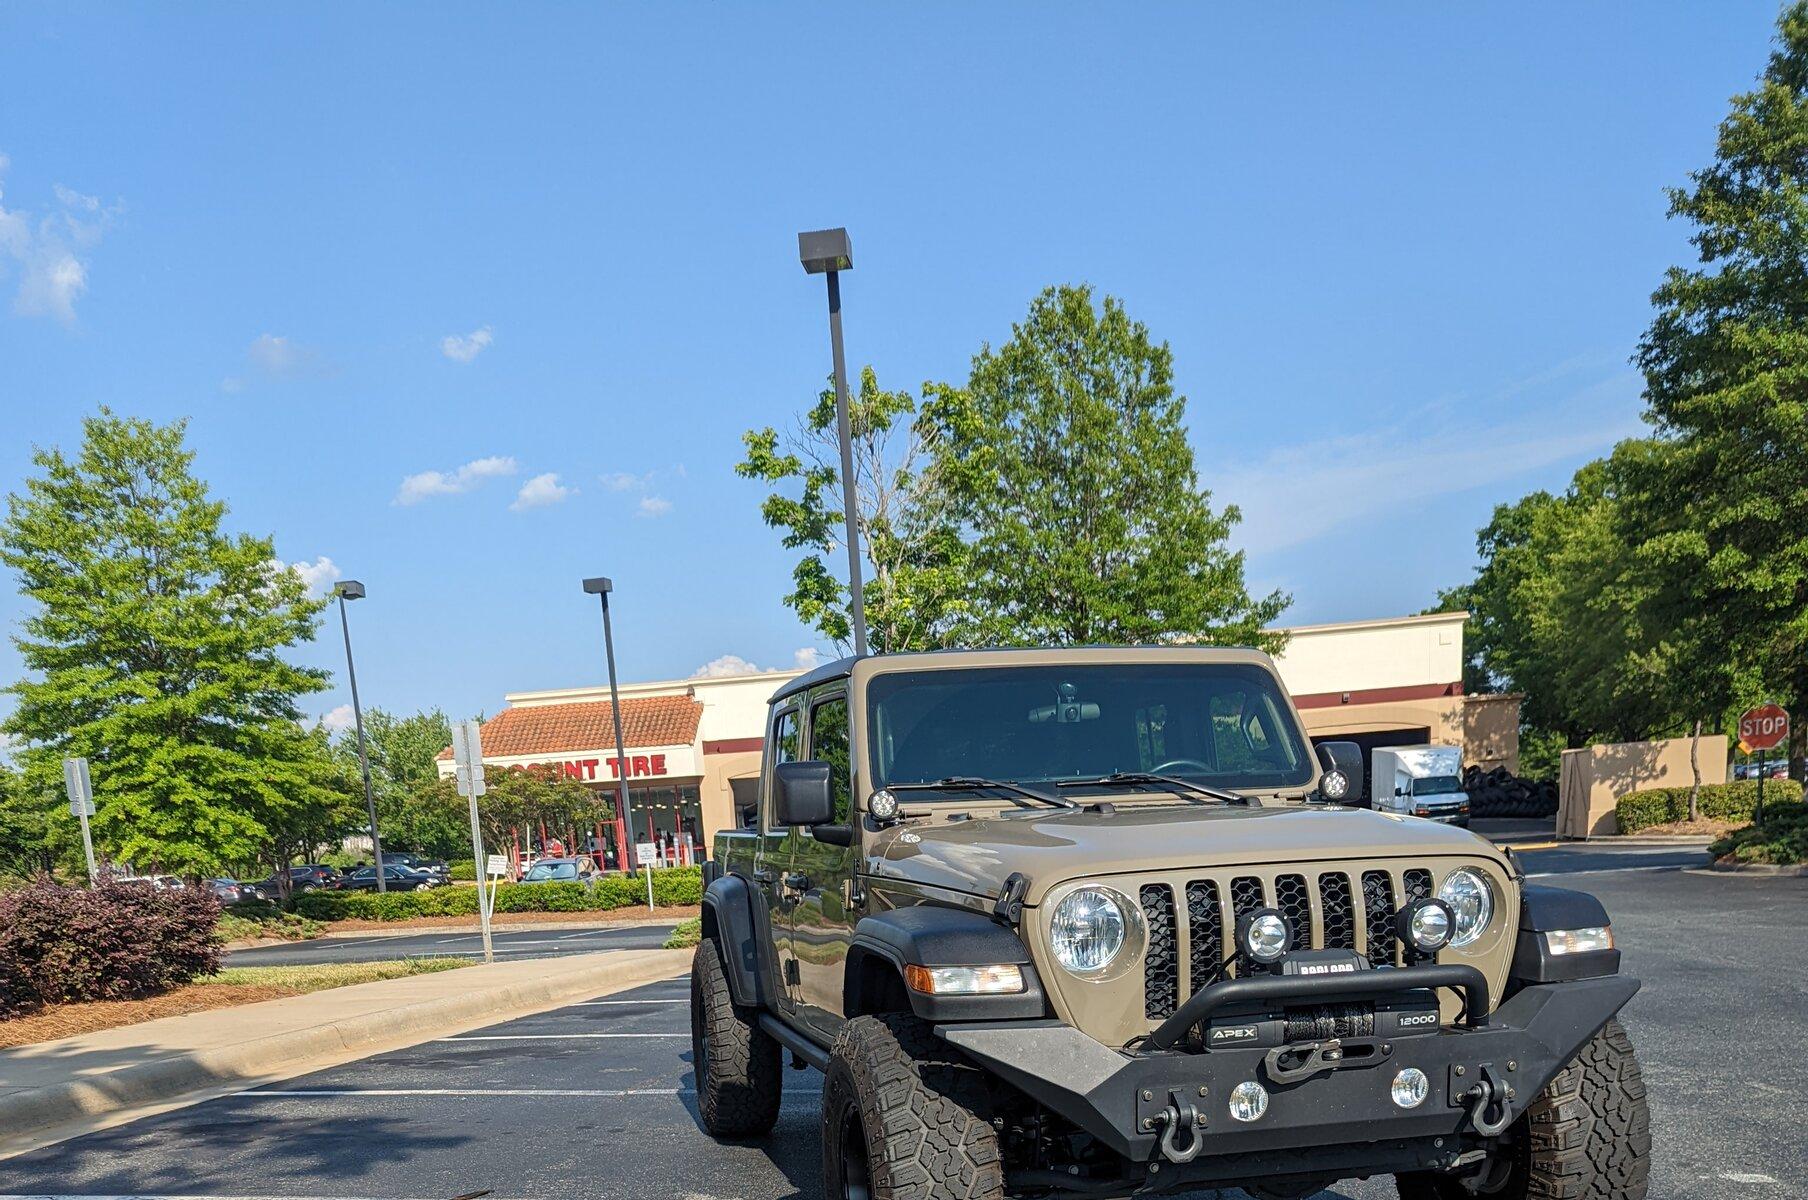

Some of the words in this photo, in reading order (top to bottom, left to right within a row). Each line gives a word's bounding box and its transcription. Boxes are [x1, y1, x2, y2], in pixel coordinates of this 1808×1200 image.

[1743, 717, 1786, 737] STOP
[606, 754, 668, 779] TIRE
[1400, 1015, 1436, 1026] 12000
[1213, 1029, 1255, 1039] APEX
